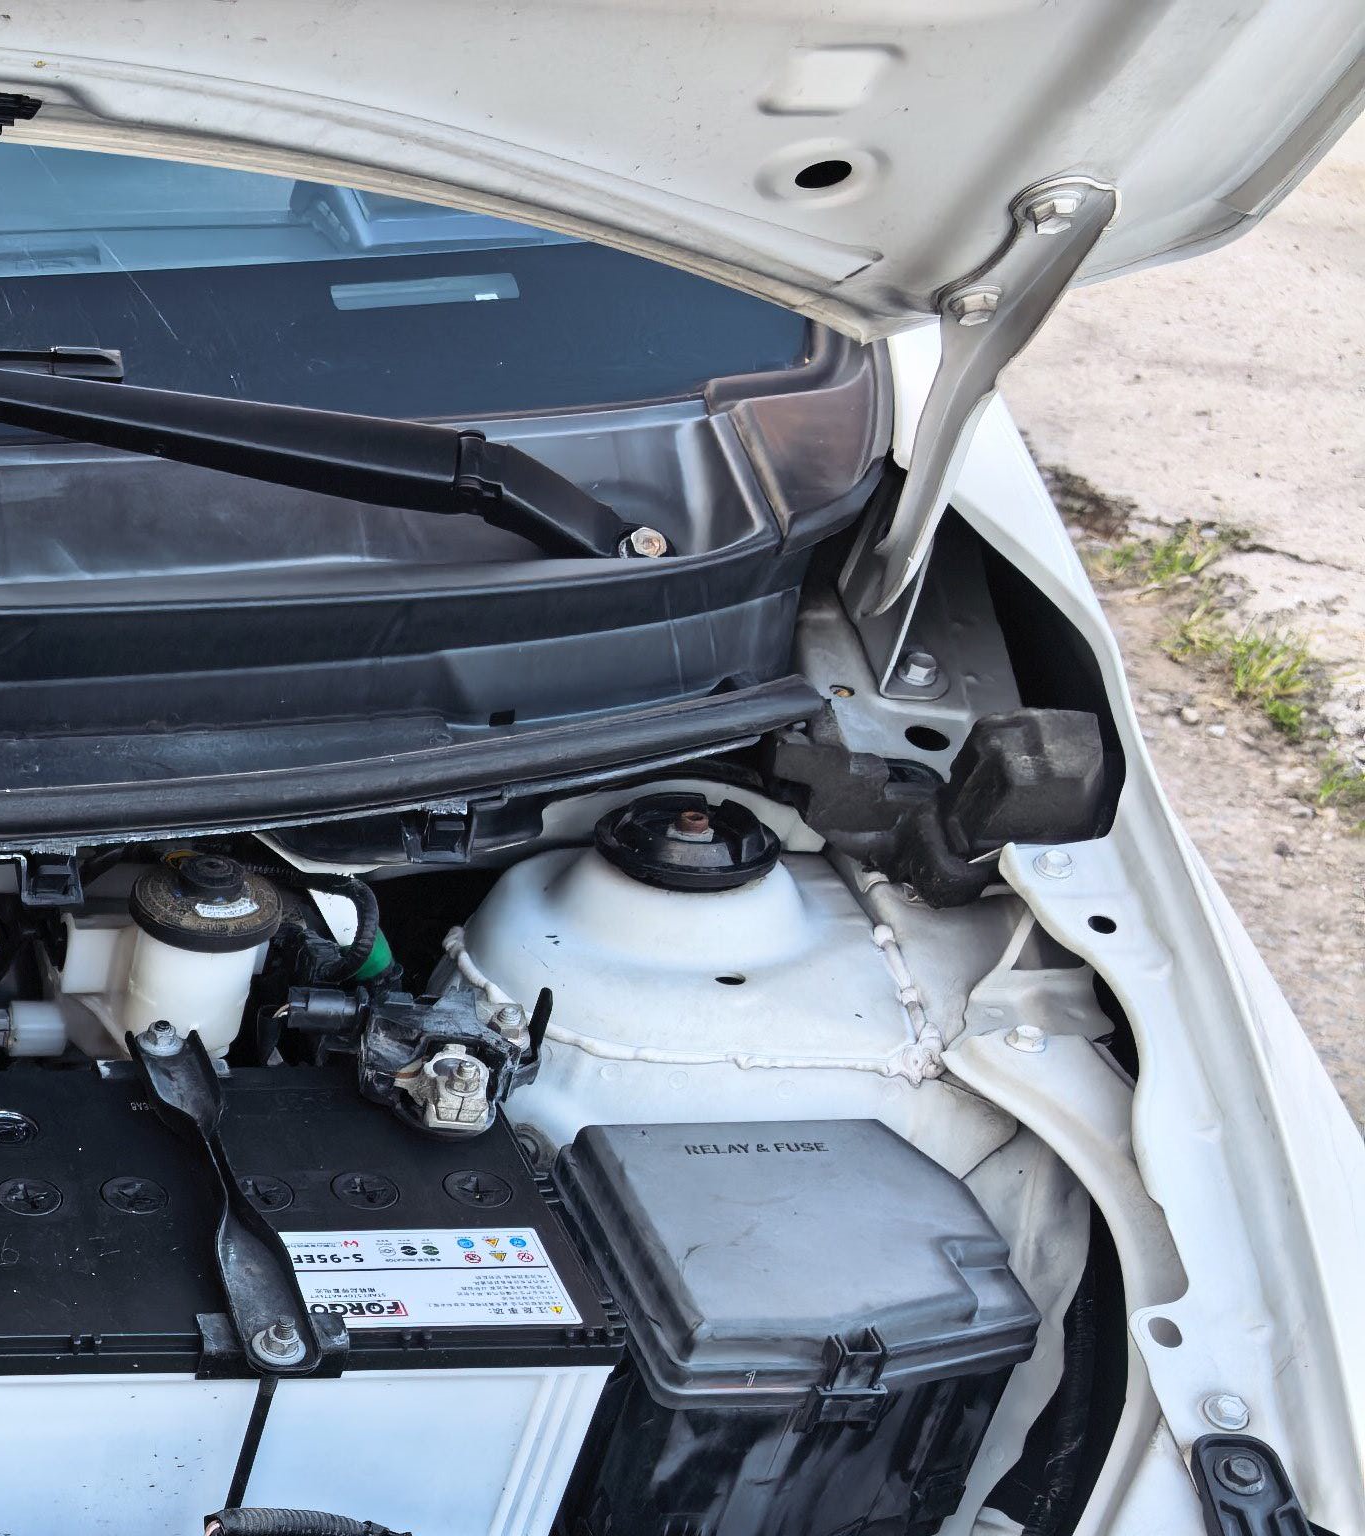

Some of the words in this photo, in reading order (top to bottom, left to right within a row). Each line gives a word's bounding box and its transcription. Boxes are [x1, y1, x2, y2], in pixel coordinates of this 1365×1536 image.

[685, 1143, 749, 1155] RELAY
[756, 1143, 770, 1153] &
[774, 1141, 829, 1153] FUSE
